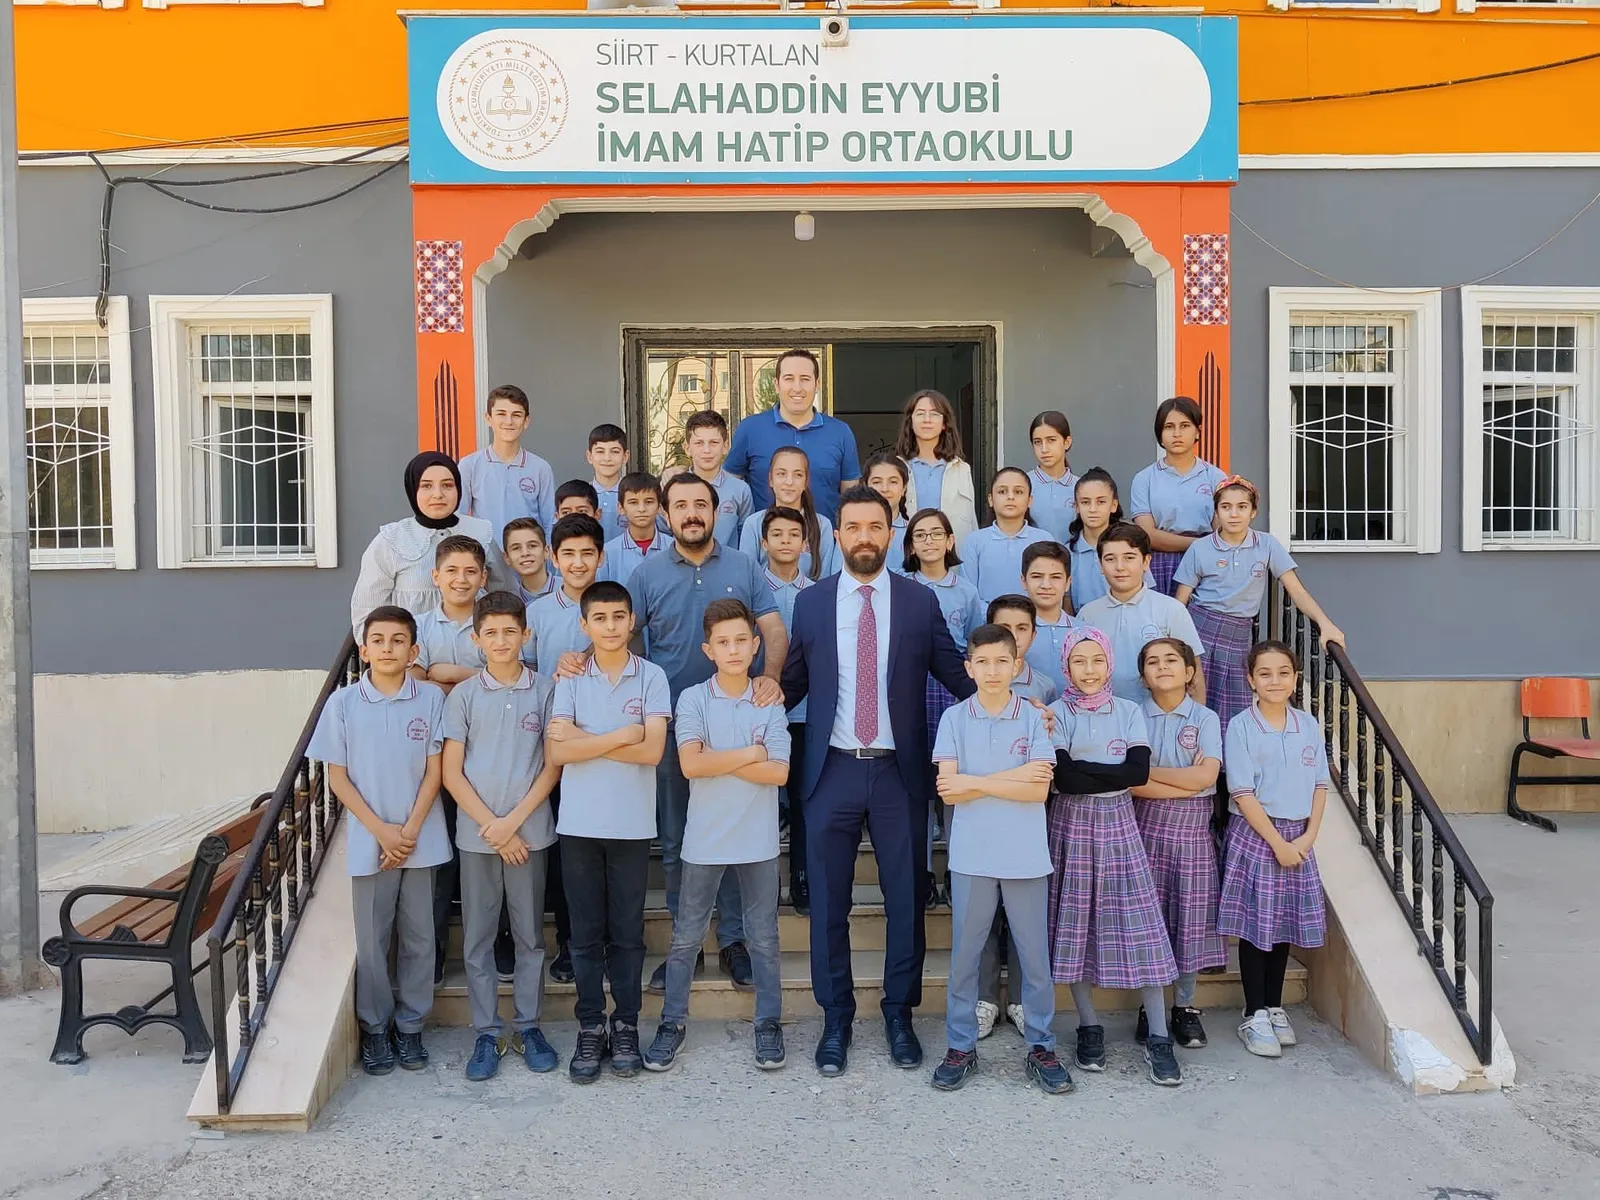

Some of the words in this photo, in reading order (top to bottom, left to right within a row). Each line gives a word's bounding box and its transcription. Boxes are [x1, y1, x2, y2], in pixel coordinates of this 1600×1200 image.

[596, 39, 659, 66] SİİRT
[685, 43, 819, 66] KURTALAN
[596, 74, 847, 114] SELAHADDİN
[862, 73, 1000, 113] EYYUBİ
[598, 122, 703, 162] İMAM
[717, 122, 829, 162] HATİP
[842, 130, 1073, 162] ORTAOKULU
